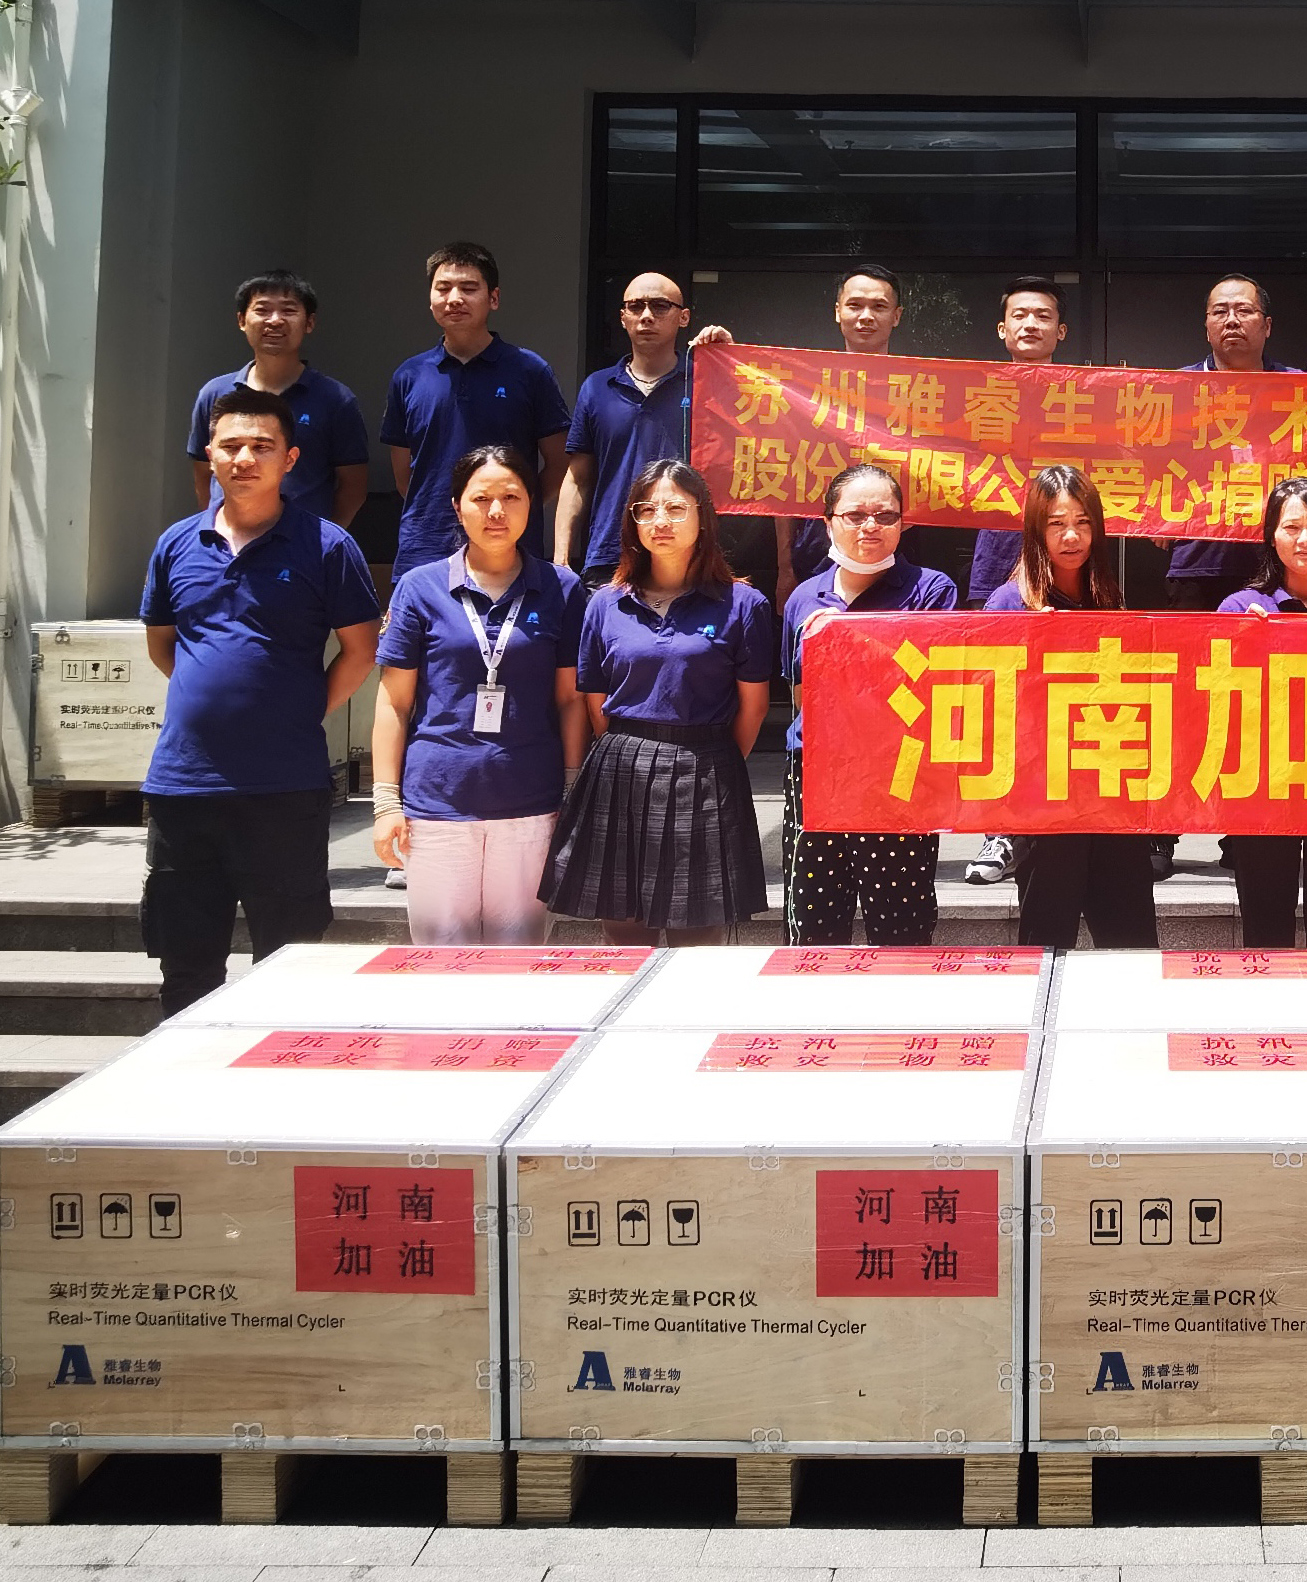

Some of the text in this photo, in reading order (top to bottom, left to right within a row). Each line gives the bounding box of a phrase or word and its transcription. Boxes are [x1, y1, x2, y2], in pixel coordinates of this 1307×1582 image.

[333, 1183, 434, 1222] 河南
[855, 1185, 960, 1224] 河南
[333, 1238, 434, 1277] 加油
[855, 1242, 958, 1281] 加油
[49, 1282, 238, 1301] 实时荧光定量PCR仪
[568, 1289, 757, 1307] 实时荧光定量PCR仪
[1089, 1289, 1277, 1307] 实时荧光定量PCR仪
[48, 1311, 345, 1330] Real-Time Quantitative Thermal Cycler
[568, 1316, 866, 1336] Real-Time Quantitative Thermal Cycler
[1088, 1318, 1169, 1332] Real-Time
[1175, 1318, 1266, 1333] Quantitative
[623, 1366, 682, 1381] 雅睿生物
[1141, 1362, 1200, 1378] 雅睿生物
[103, 1374, 162, 1387] Molarray
[623, 1381, 681, 1396] Molarray
[1141, 1379, 1200, 1391] Molarray
